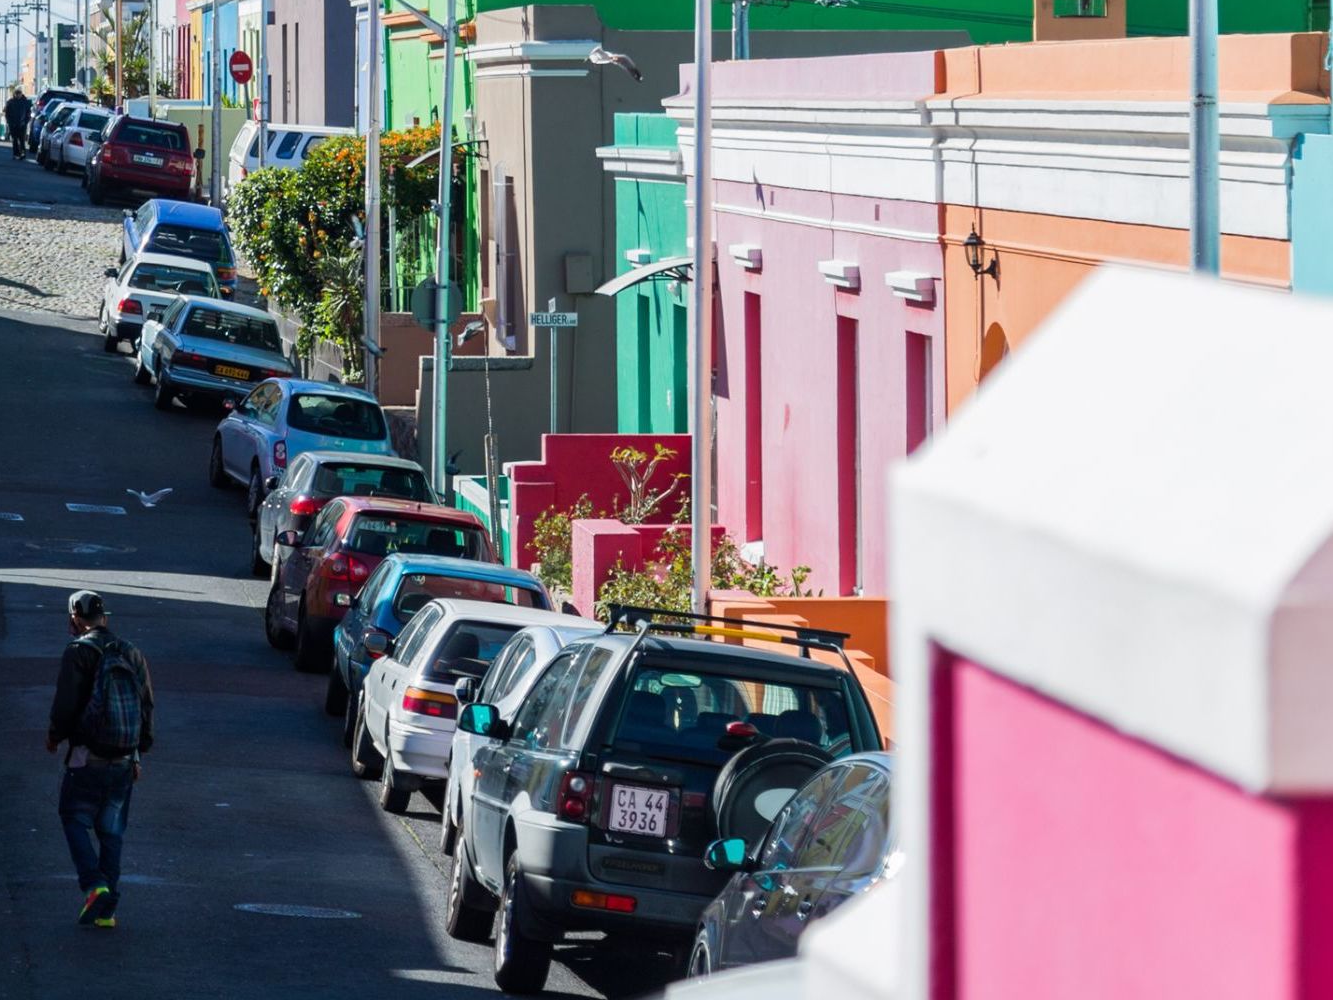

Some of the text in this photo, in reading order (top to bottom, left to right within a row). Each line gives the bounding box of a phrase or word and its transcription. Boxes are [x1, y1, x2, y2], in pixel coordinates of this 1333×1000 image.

[531, 314, 567, 325] HELLIGER
[617, 790, 664, 812] CA 44
[618, 809, 657, 831] 3936
